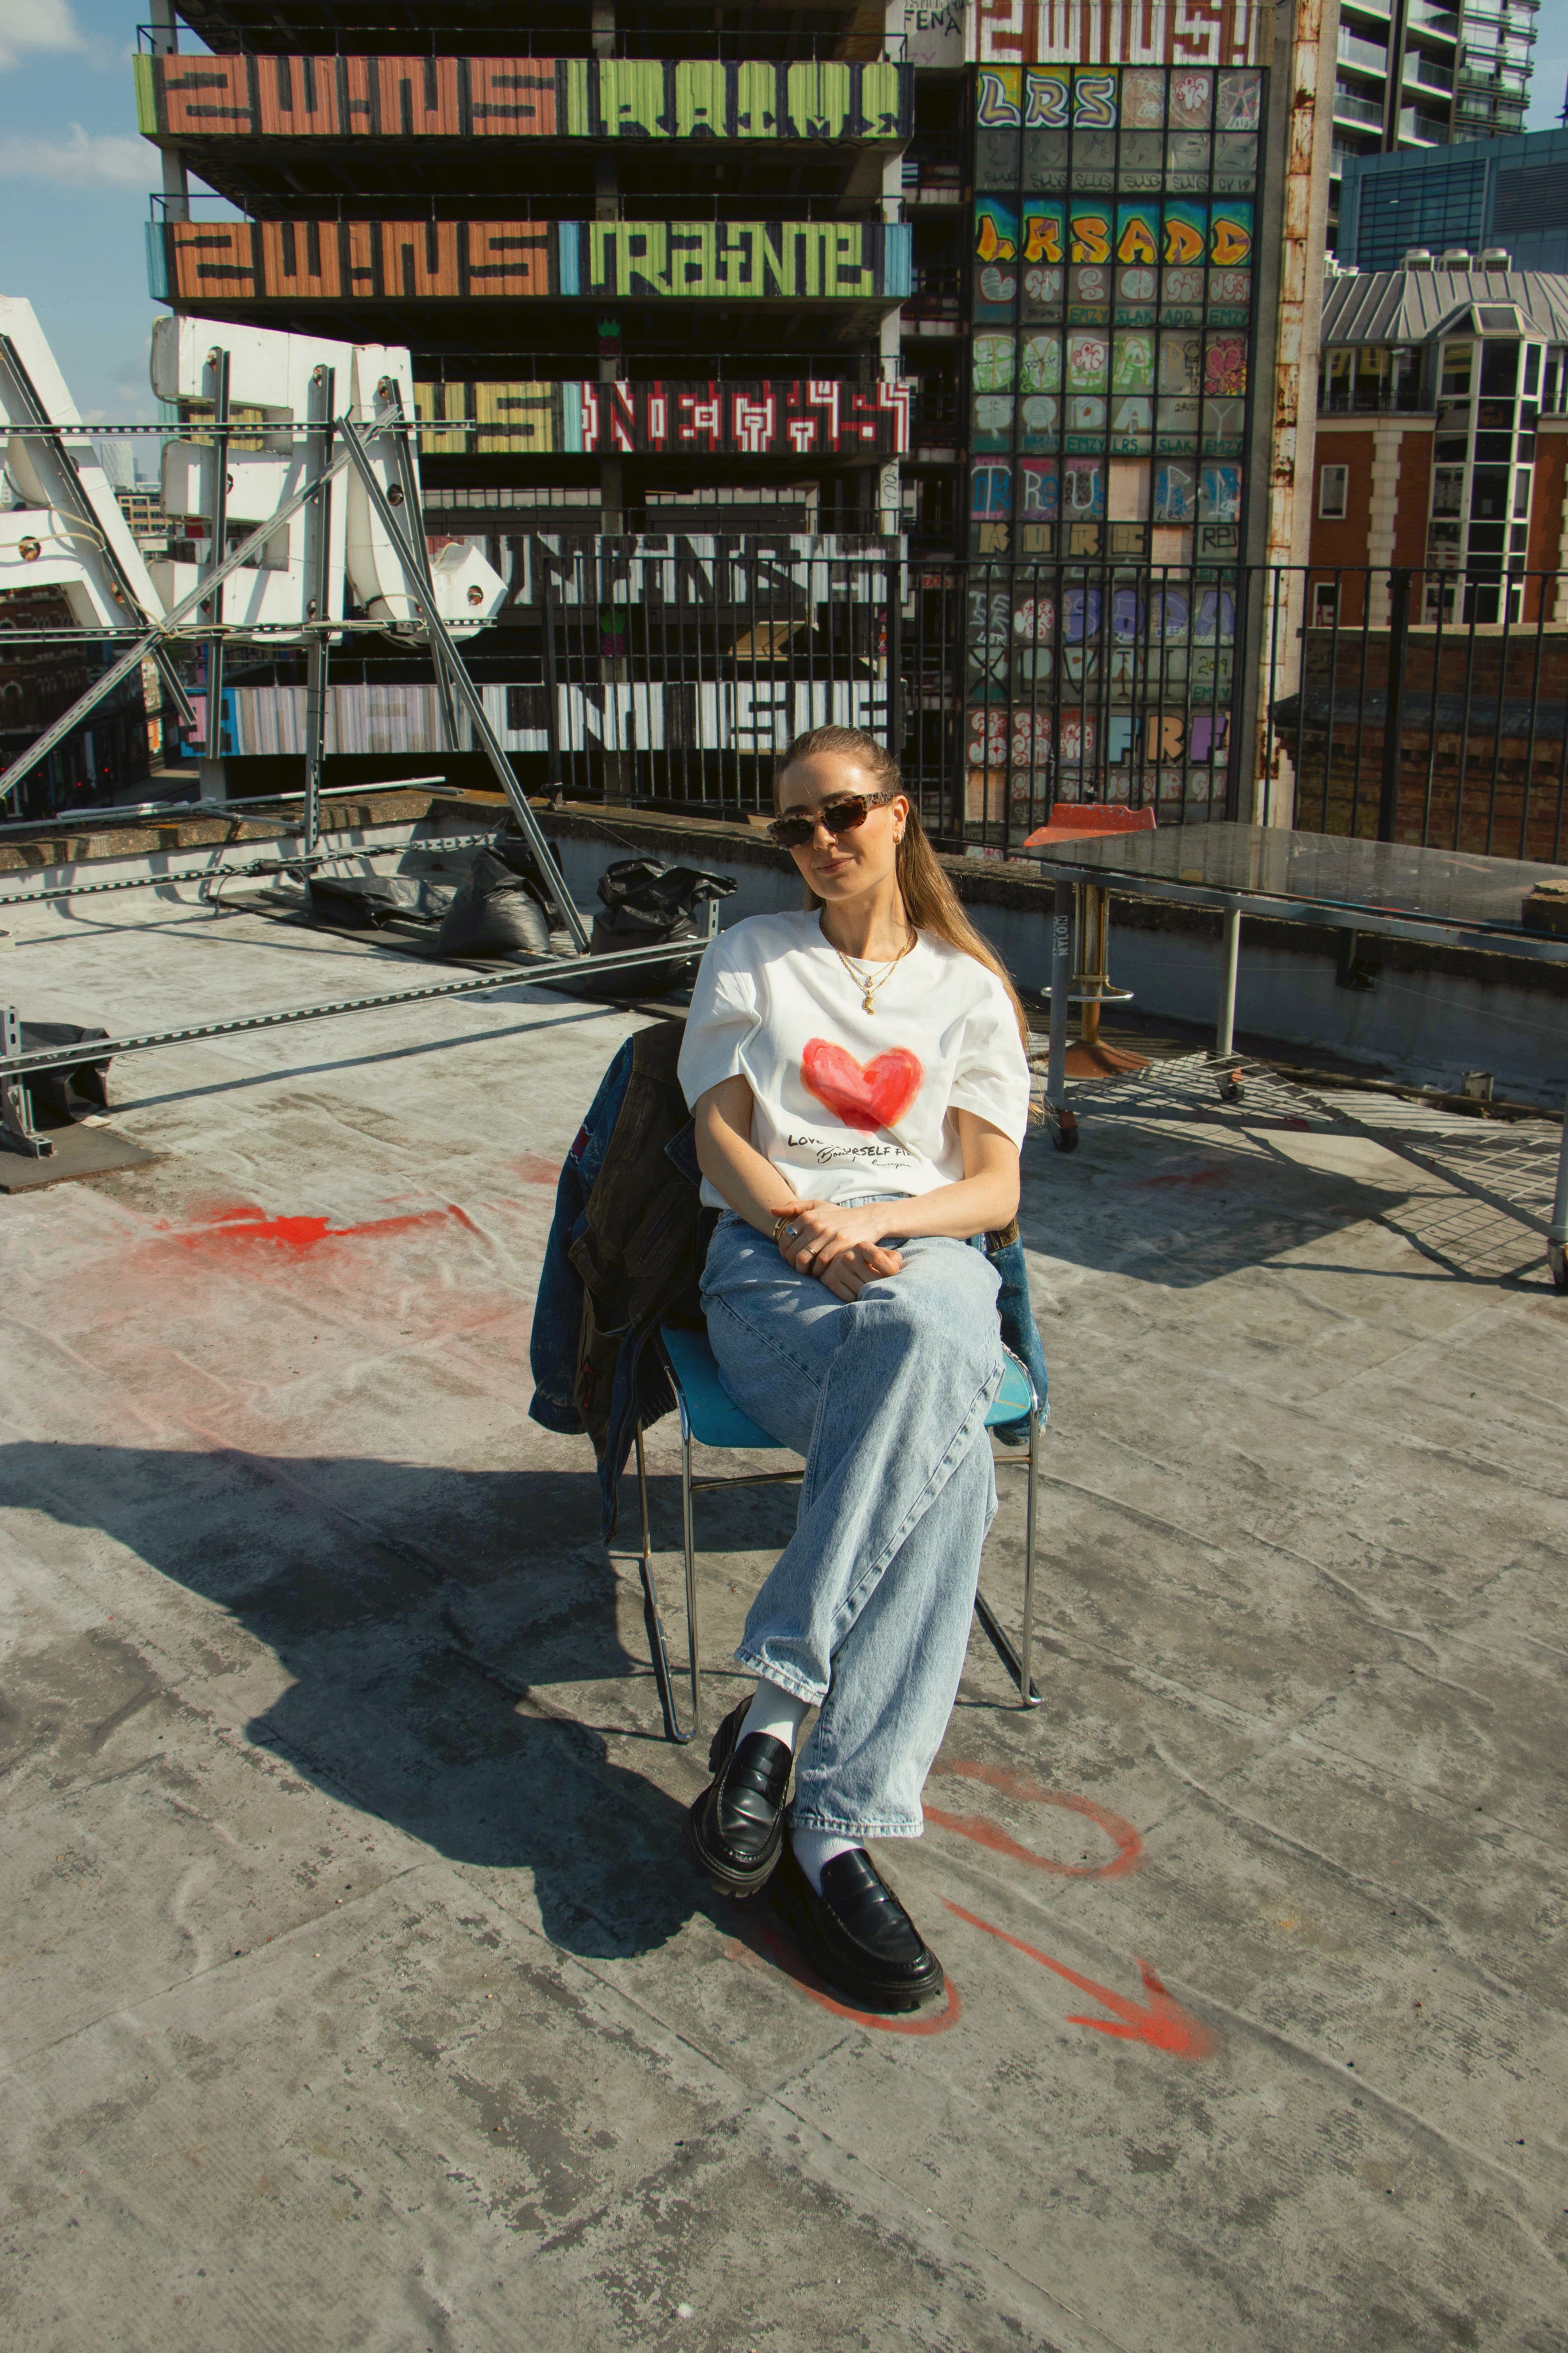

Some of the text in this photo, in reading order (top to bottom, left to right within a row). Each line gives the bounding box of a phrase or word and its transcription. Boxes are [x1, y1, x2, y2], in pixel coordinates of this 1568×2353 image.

[904, 9, 961, 37] FENA
[978, 73, 1116, 128] LRS
[1057, 915, 1069, 957] NYLON
